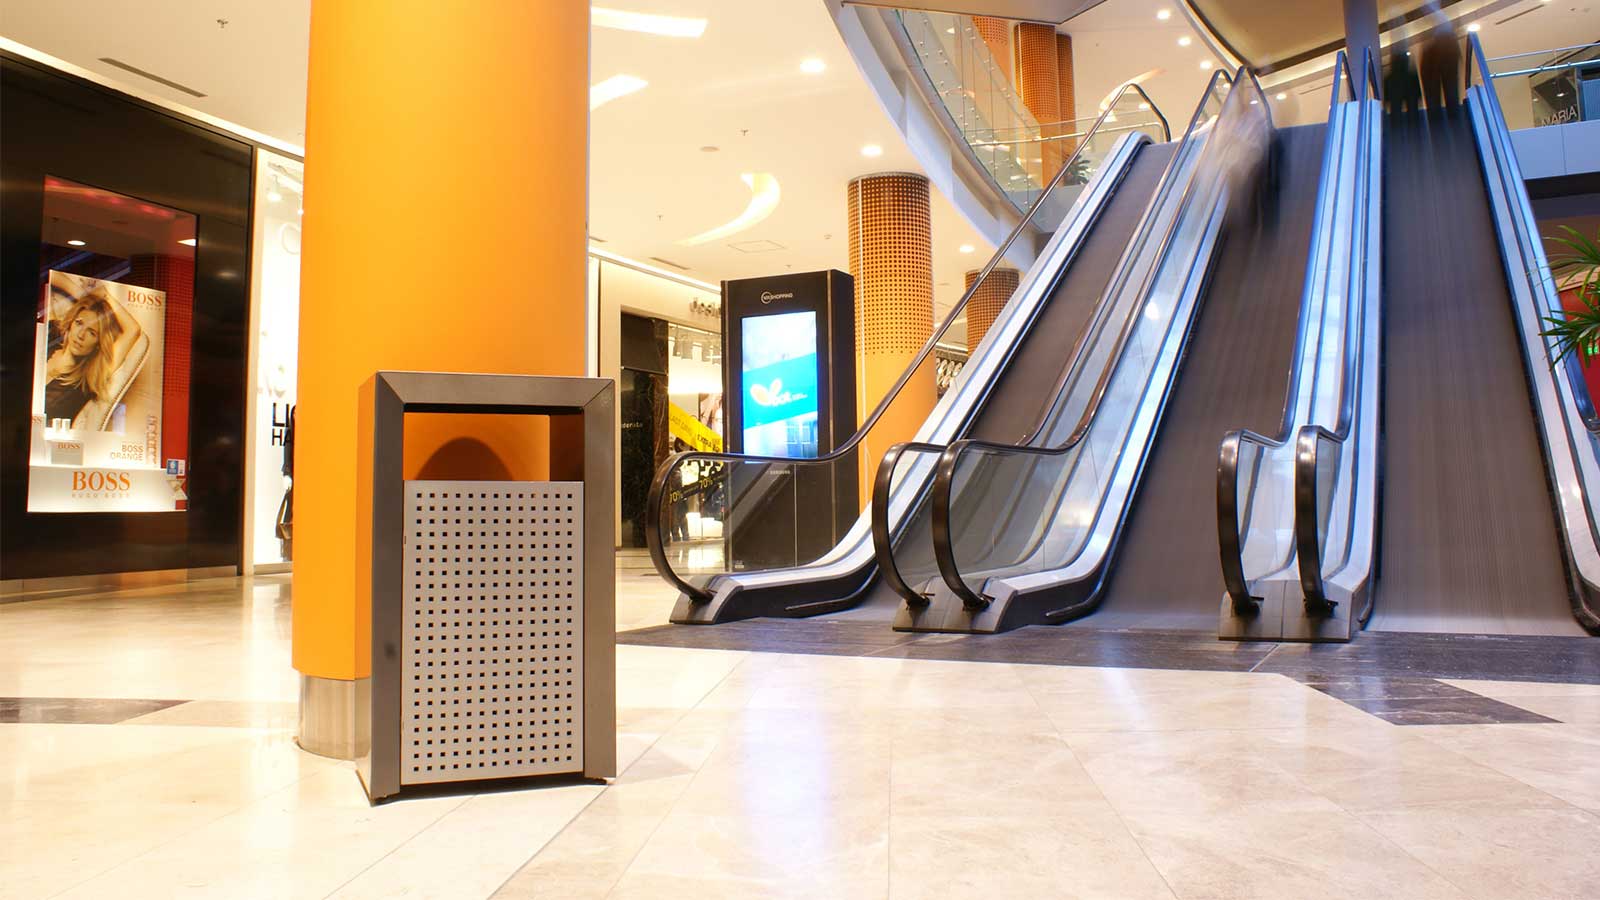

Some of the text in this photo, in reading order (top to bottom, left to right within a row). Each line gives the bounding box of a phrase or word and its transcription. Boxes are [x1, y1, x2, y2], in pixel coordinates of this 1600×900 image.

[127, 290, 162, 307] BOSS
[121, 444, 144, 452] BOSS
[110, 452, 144, 461] ORANGE
[72, 471, 130, 491] BOSS
